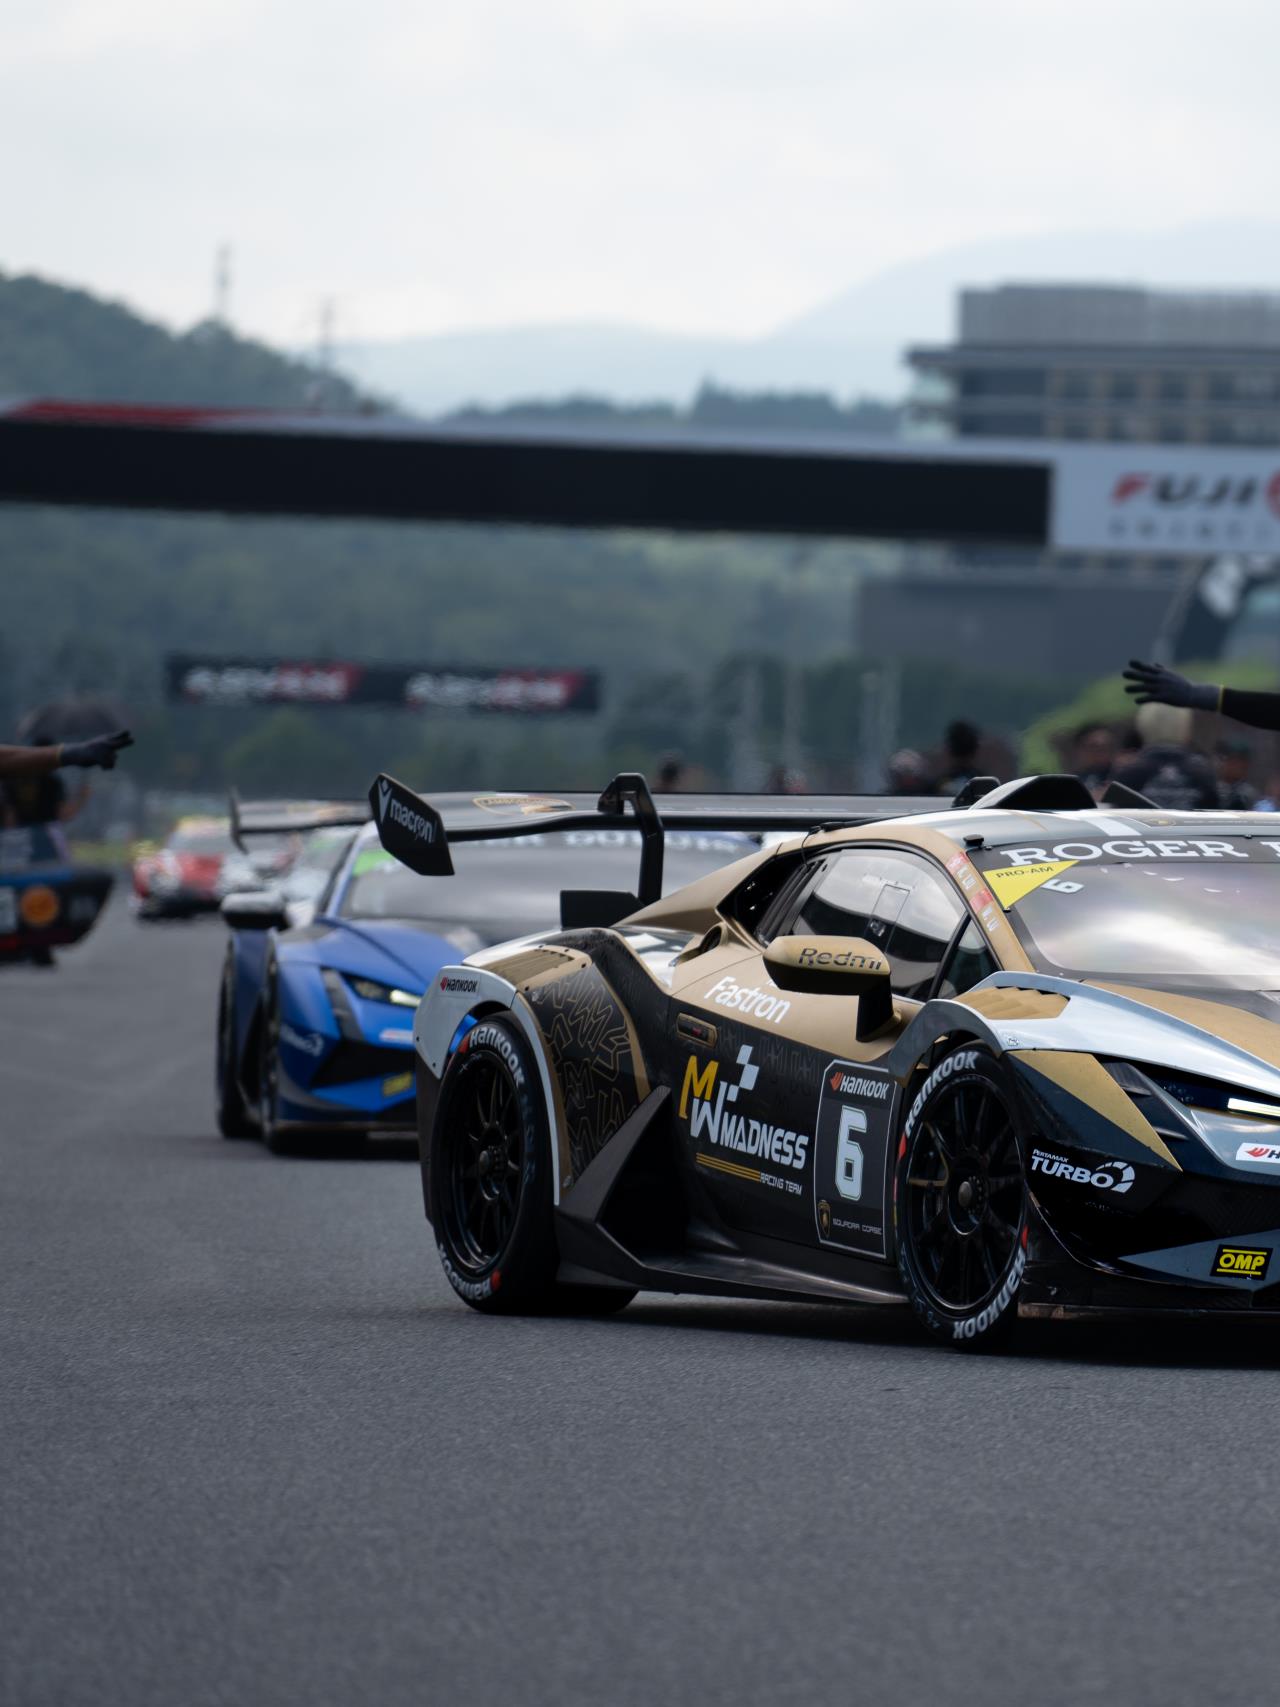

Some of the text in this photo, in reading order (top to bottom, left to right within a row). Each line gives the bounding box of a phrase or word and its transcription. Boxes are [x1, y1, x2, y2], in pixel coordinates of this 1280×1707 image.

[1112, 473, 1259, 509] FUJI
[389, 798, 433, 844] macron
[999, 839, 1249, 867] ROGER
[995, 865, 1055, 878] PRO-AM
[1041, 878, 1085, 893] 6
[798, 947, 882, 971] Redmi
[704, 976, 791, 1024] Fastron
[835, 1104, 868, 1201] 6
[1032, 1148, 1070, 1163] PERTAMAX
[760, 1173, 802, 1195] RACING TEAM
[1030, 1156, 1114, 1189] TURBO
[1218, 1253, 1266, 1271] OMP
